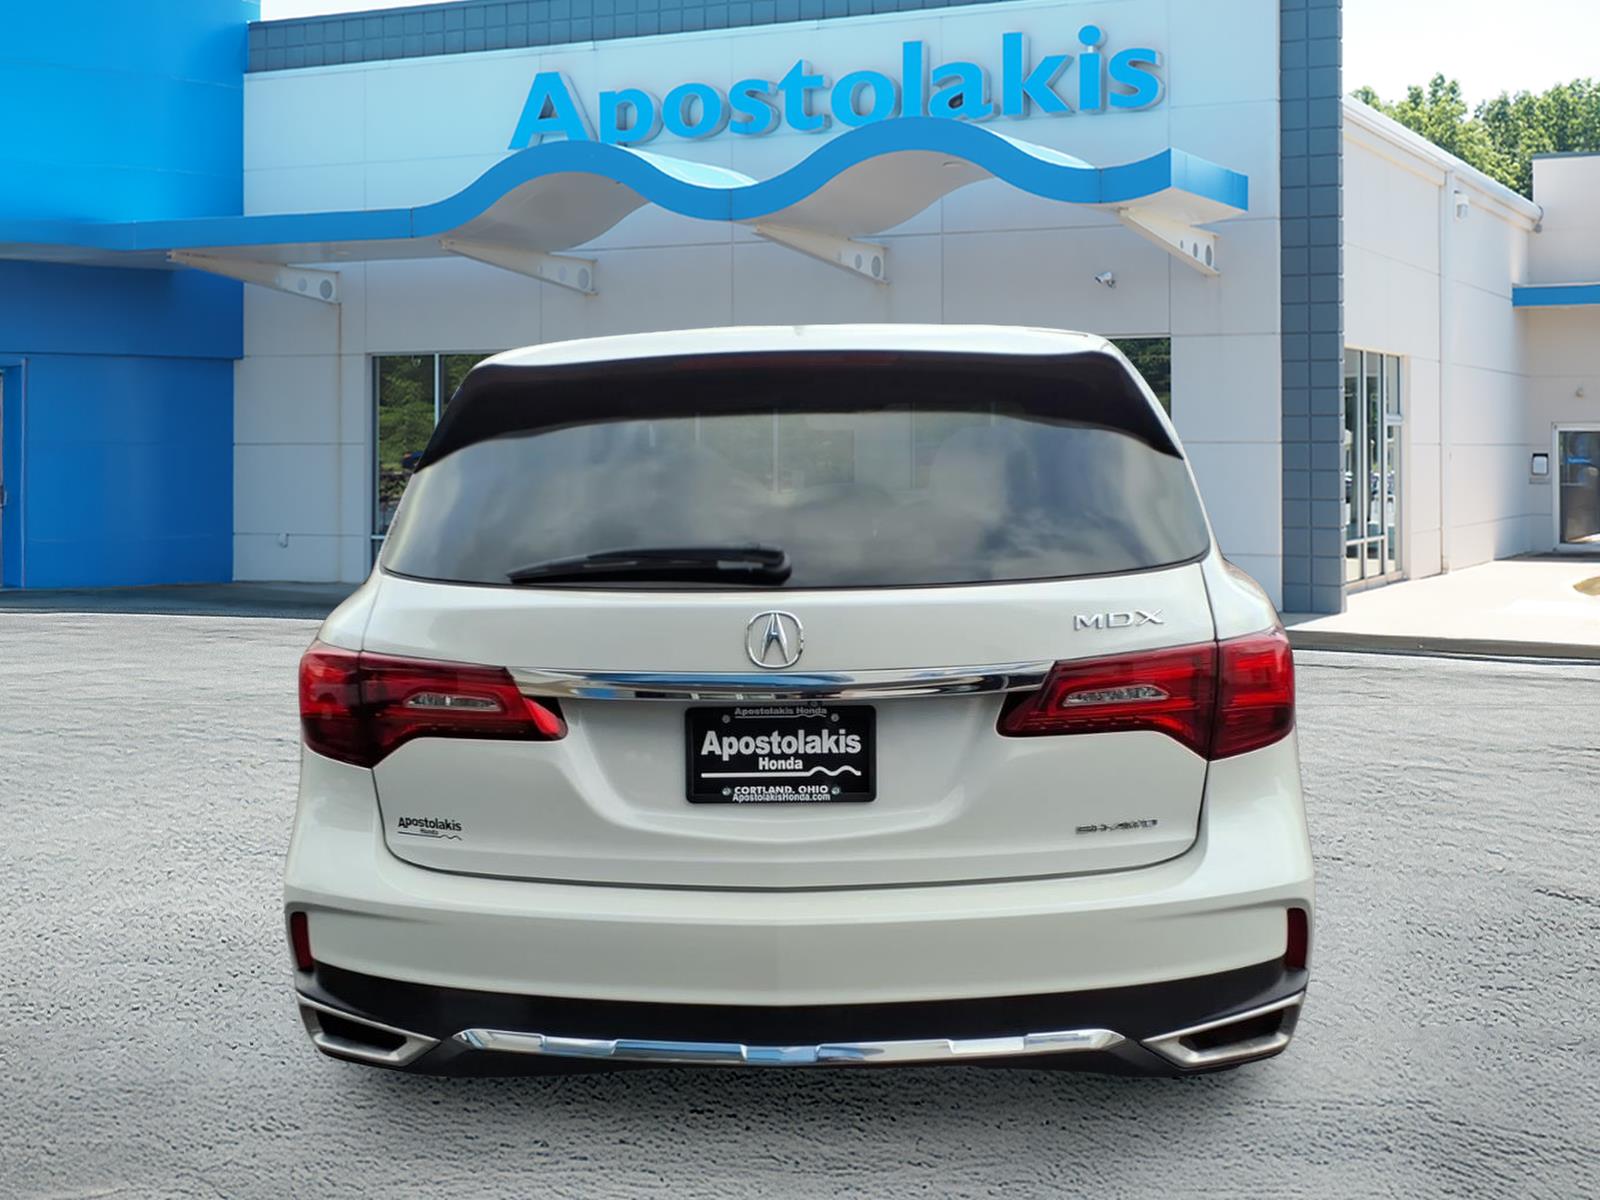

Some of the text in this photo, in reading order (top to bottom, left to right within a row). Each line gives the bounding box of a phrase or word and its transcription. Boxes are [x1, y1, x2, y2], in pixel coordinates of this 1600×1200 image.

[507, 25, 1164, 150] Apostolakis
[1073, 609, 1164, 631] MDX
[735, 706, 827, 717] Apostolakis Honda
[701, 729, 862, 761] Apostolakis
[758, 757, 803, 770] Honda
[798, 785, 829, 794] OHIO
[732, 792, 831, 803] ApostolakisHonda.com
[398, 816, 462, 831] Apostolakis
